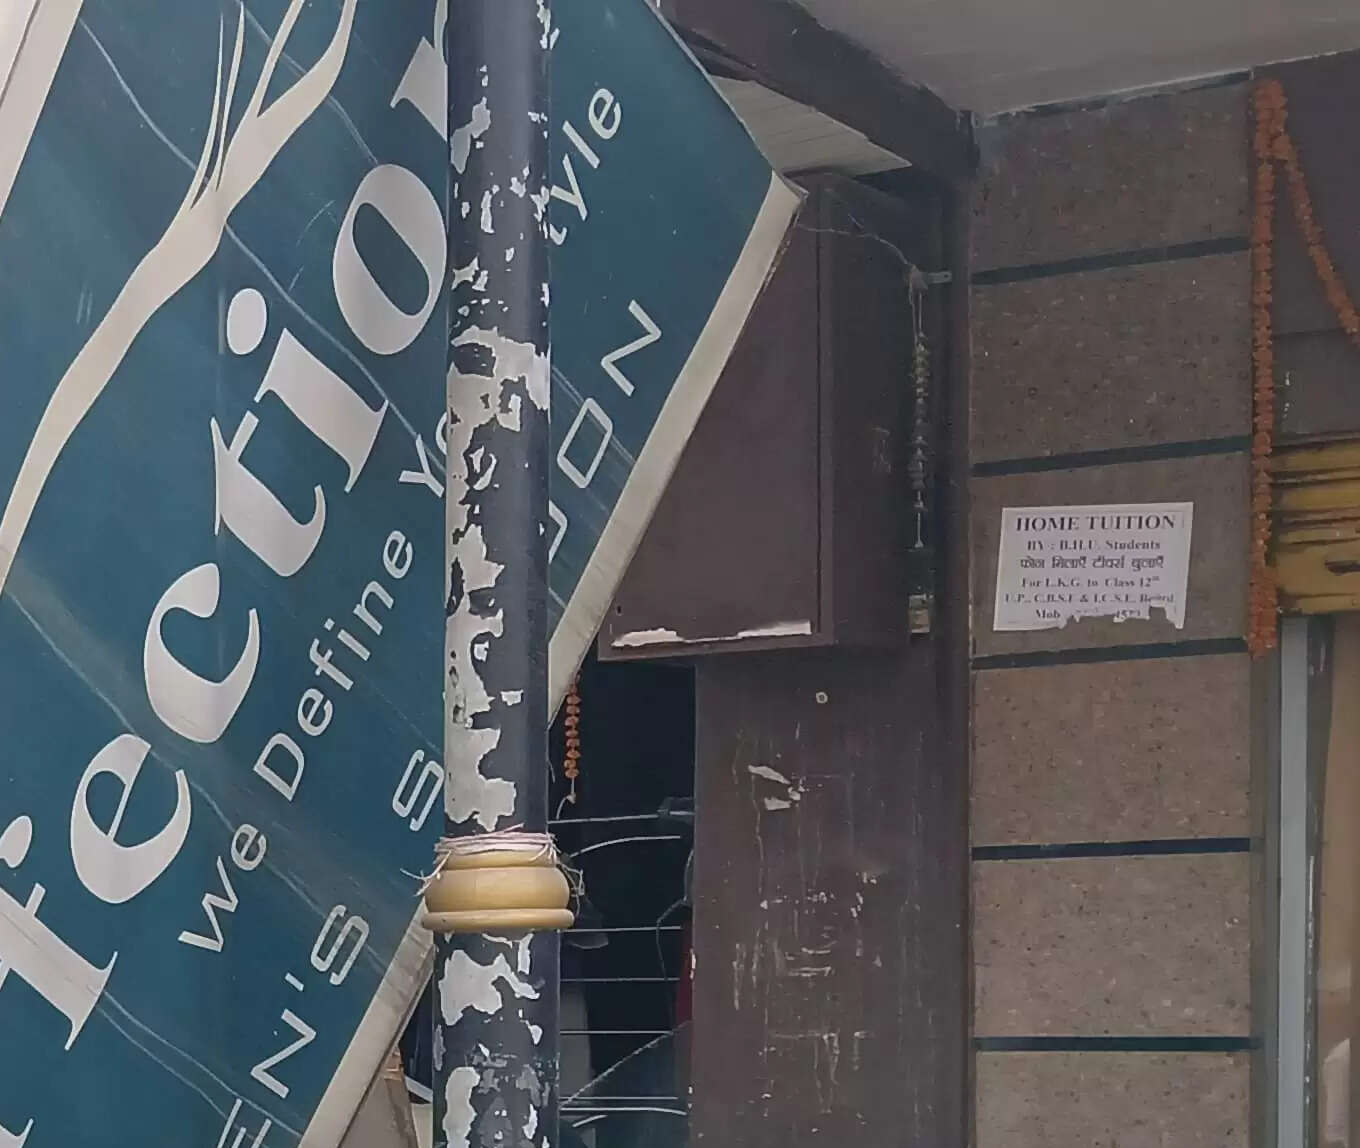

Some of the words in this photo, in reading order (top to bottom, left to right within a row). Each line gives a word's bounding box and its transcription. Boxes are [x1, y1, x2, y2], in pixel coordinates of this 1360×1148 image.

[1015, 516, 1080, 532] HOME
[1086, 514, 1175, 531] TUITION
[1105, 539, 1161, 551] Students
[1105, 576, 1136, 588] Class
[178, 822, 268, 953] We
[253, 529, 415, 803] Define
